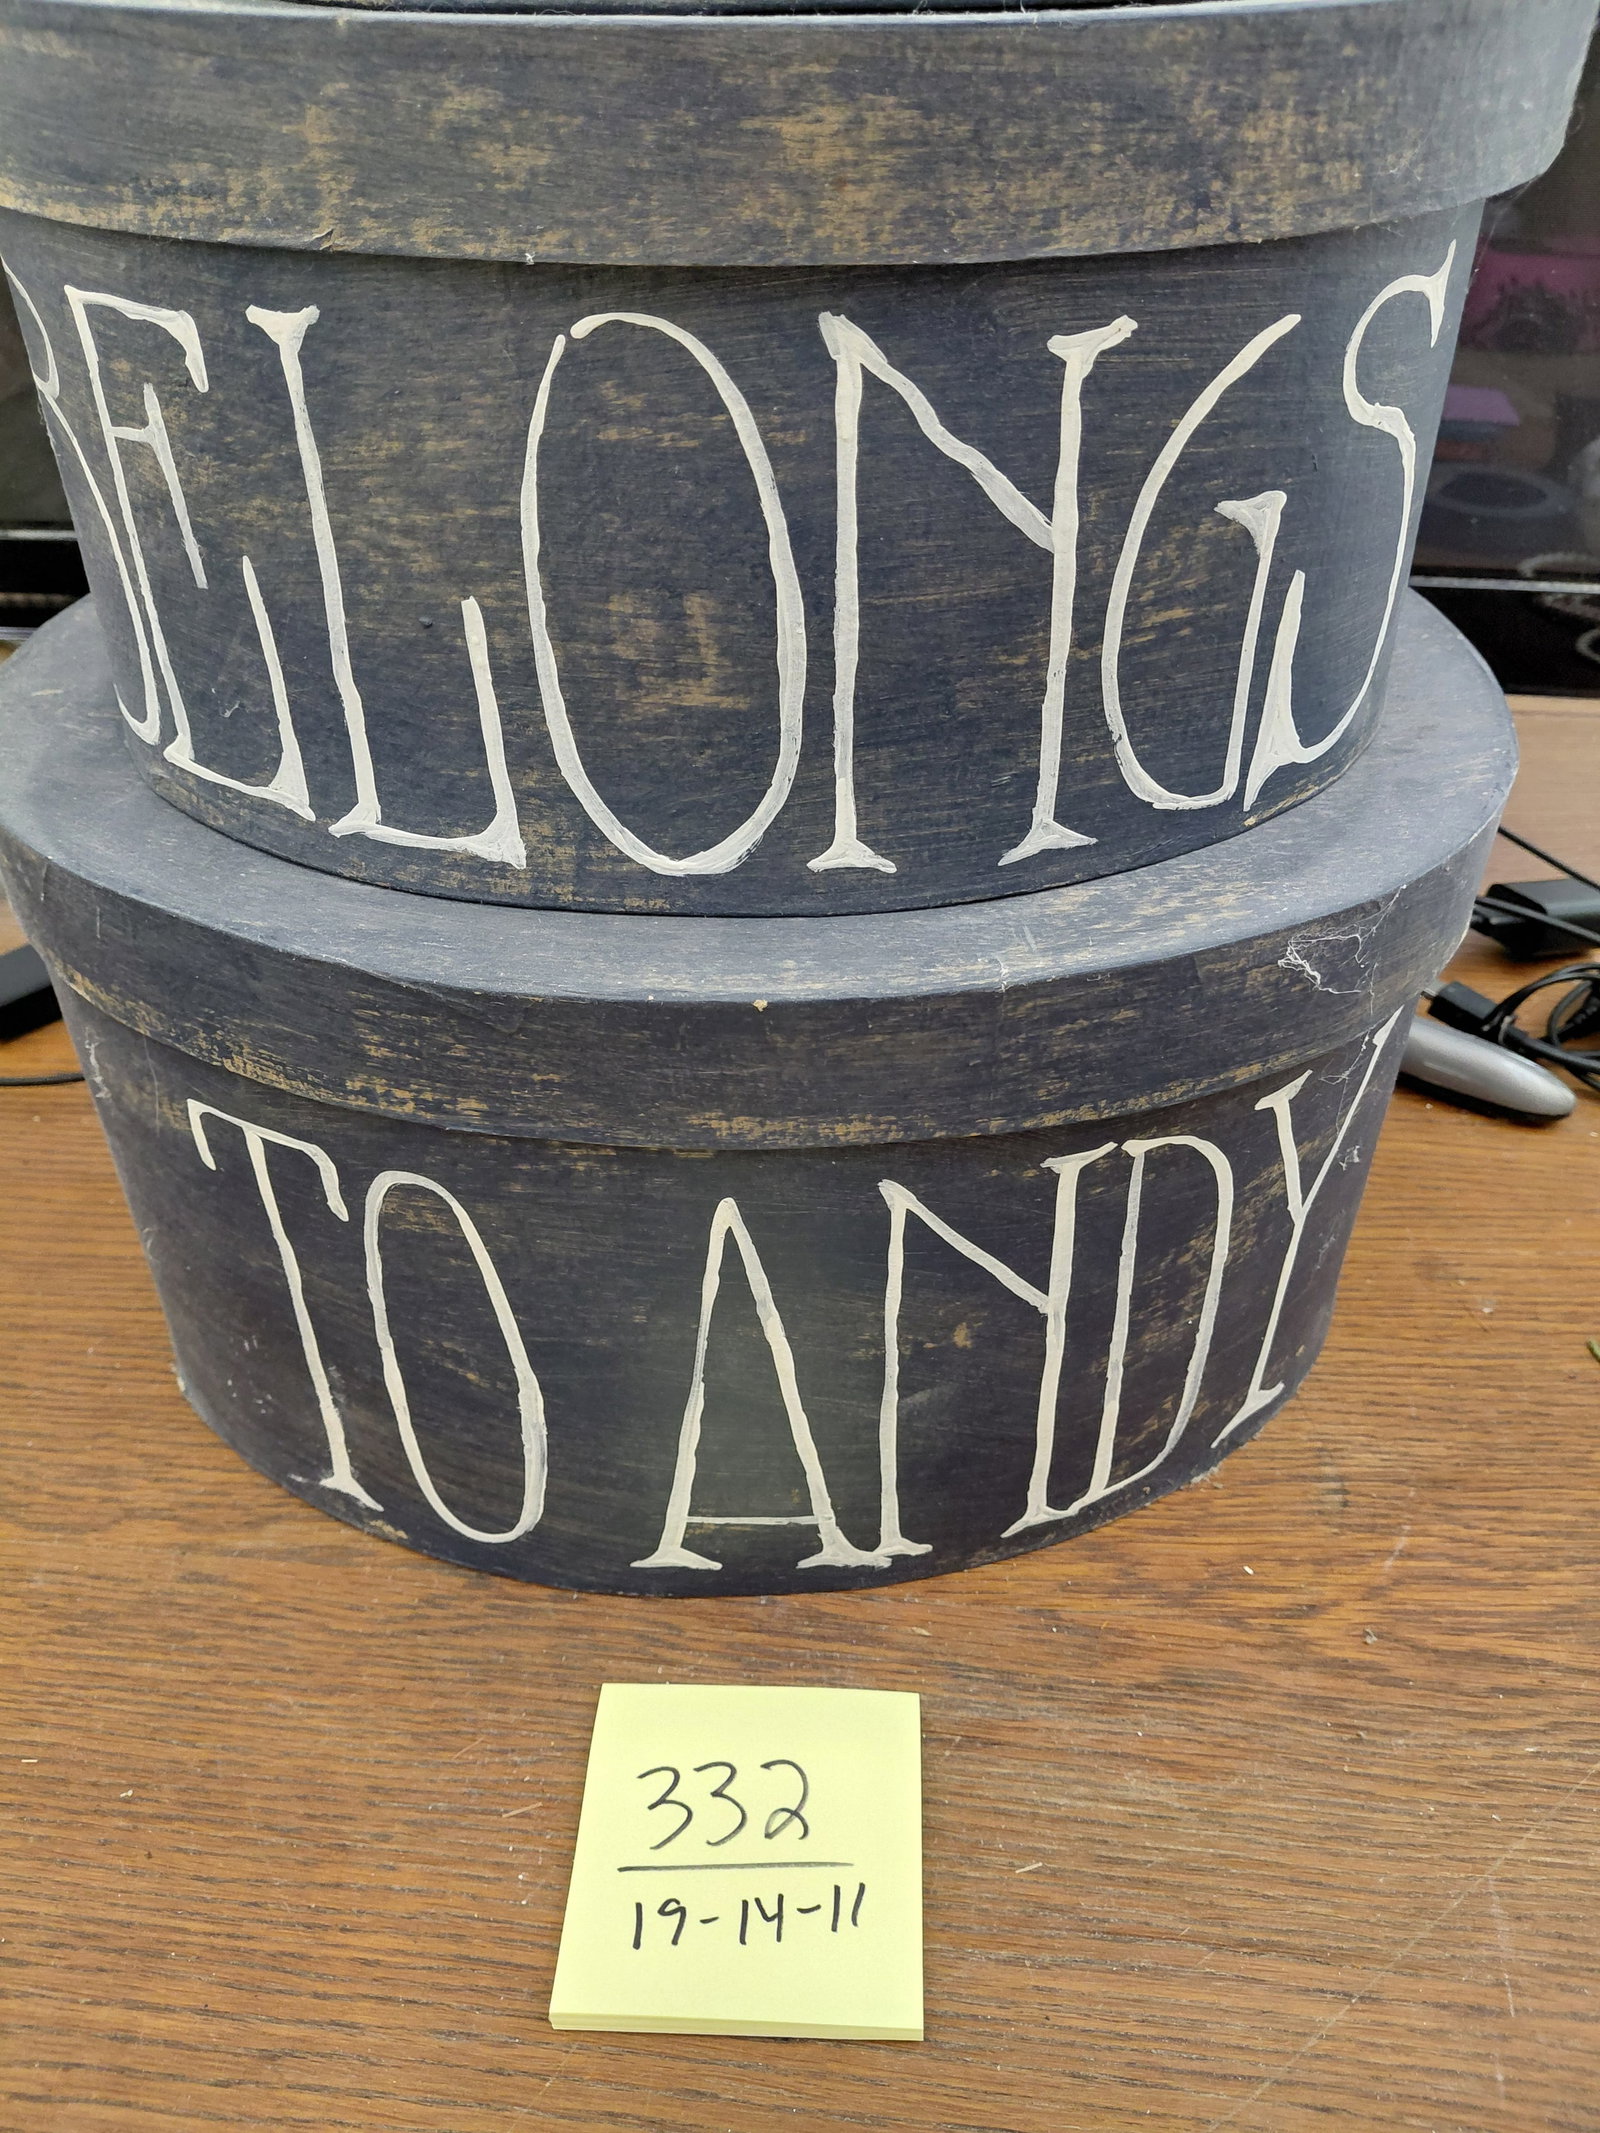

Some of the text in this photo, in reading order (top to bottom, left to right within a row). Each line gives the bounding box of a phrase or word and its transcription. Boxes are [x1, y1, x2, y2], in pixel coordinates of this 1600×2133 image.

[187, 1005, 1404, 1571] TO ANDY
[636, 1758, 810, 1851] 332
[632, 1881, 866, 1951] 19-14-11
